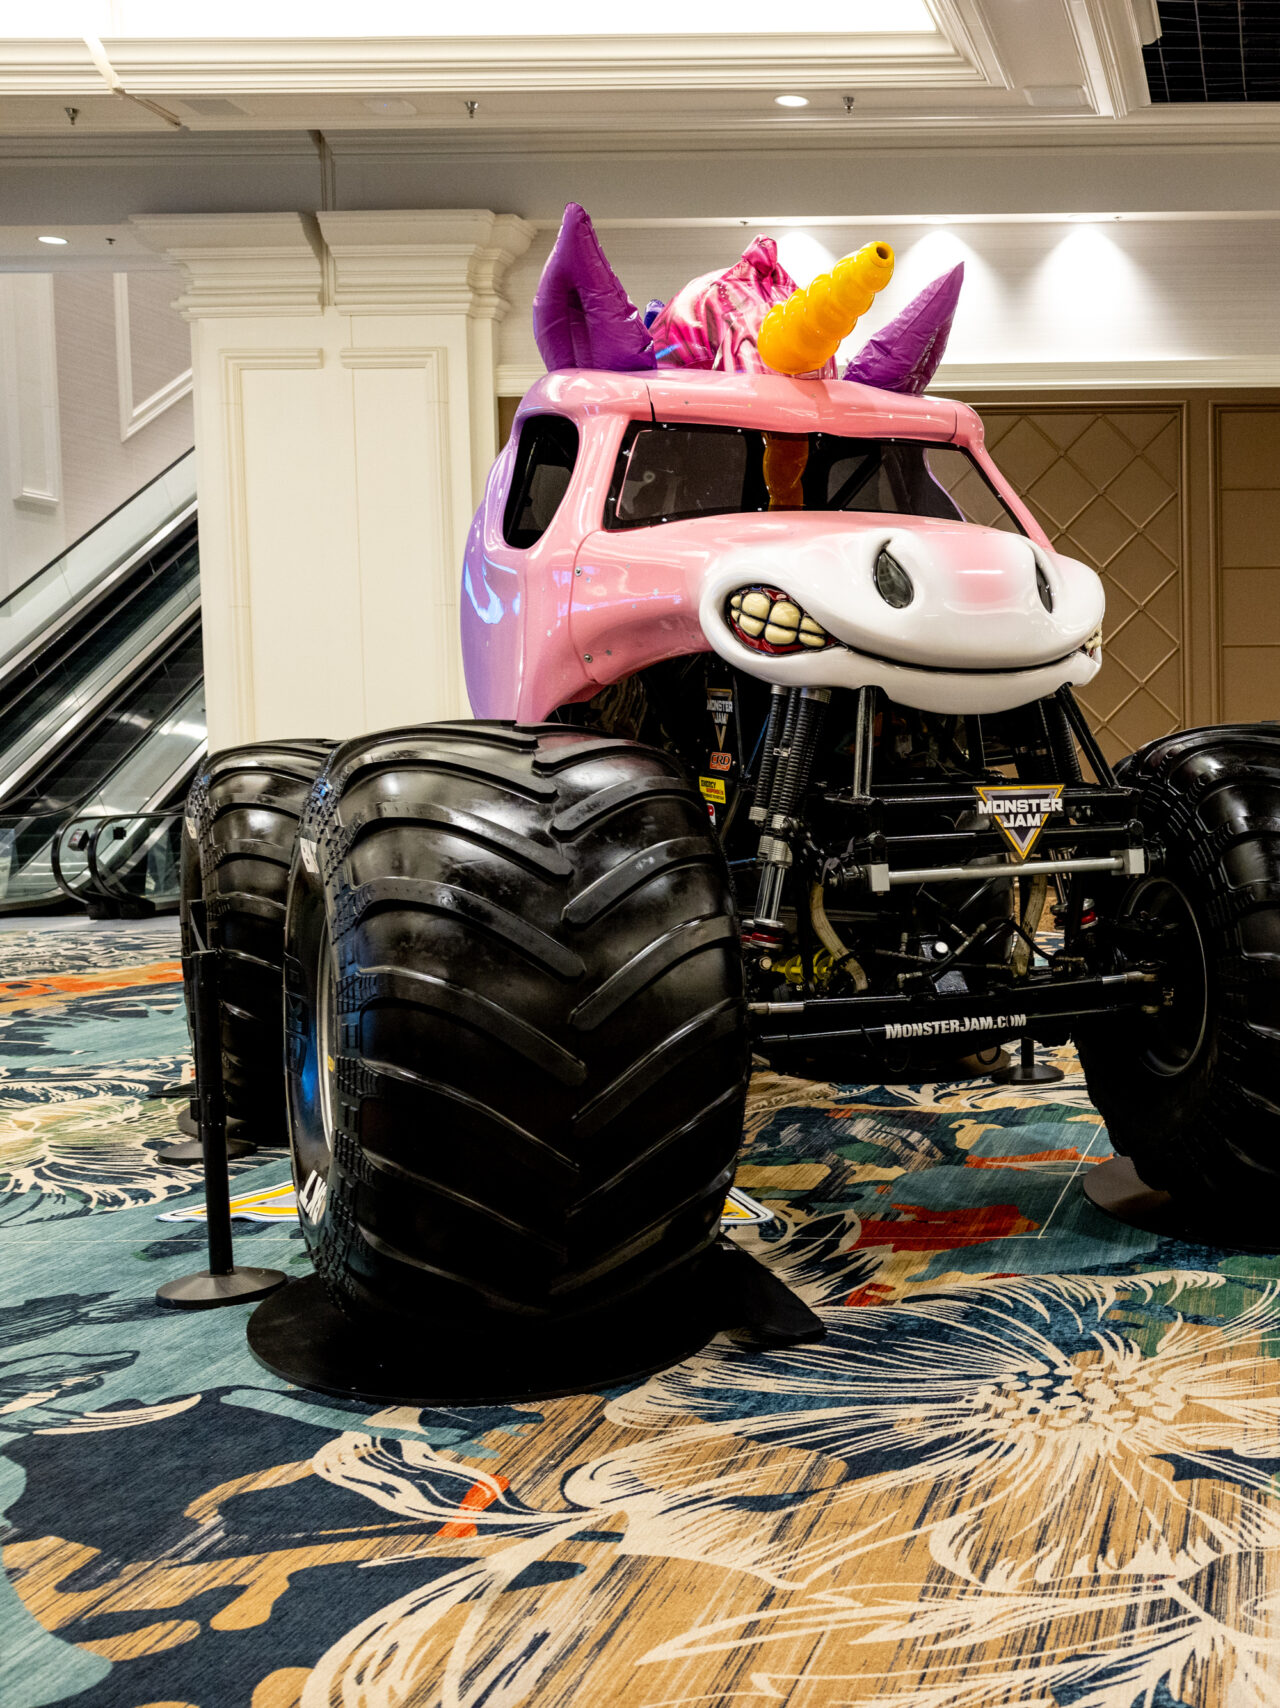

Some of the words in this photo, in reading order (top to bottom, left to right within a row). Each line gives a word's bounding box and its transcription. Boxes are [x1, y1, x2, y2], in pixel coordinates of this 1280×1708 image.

[707, 699, 733, 712] MONSTER
[714, 712, 727, 724] JAM
[711, 754, 730, 766] CRD
[978, 798, 1063, 814] MONSTER
[1004, 813, 1041, 827] JAM
